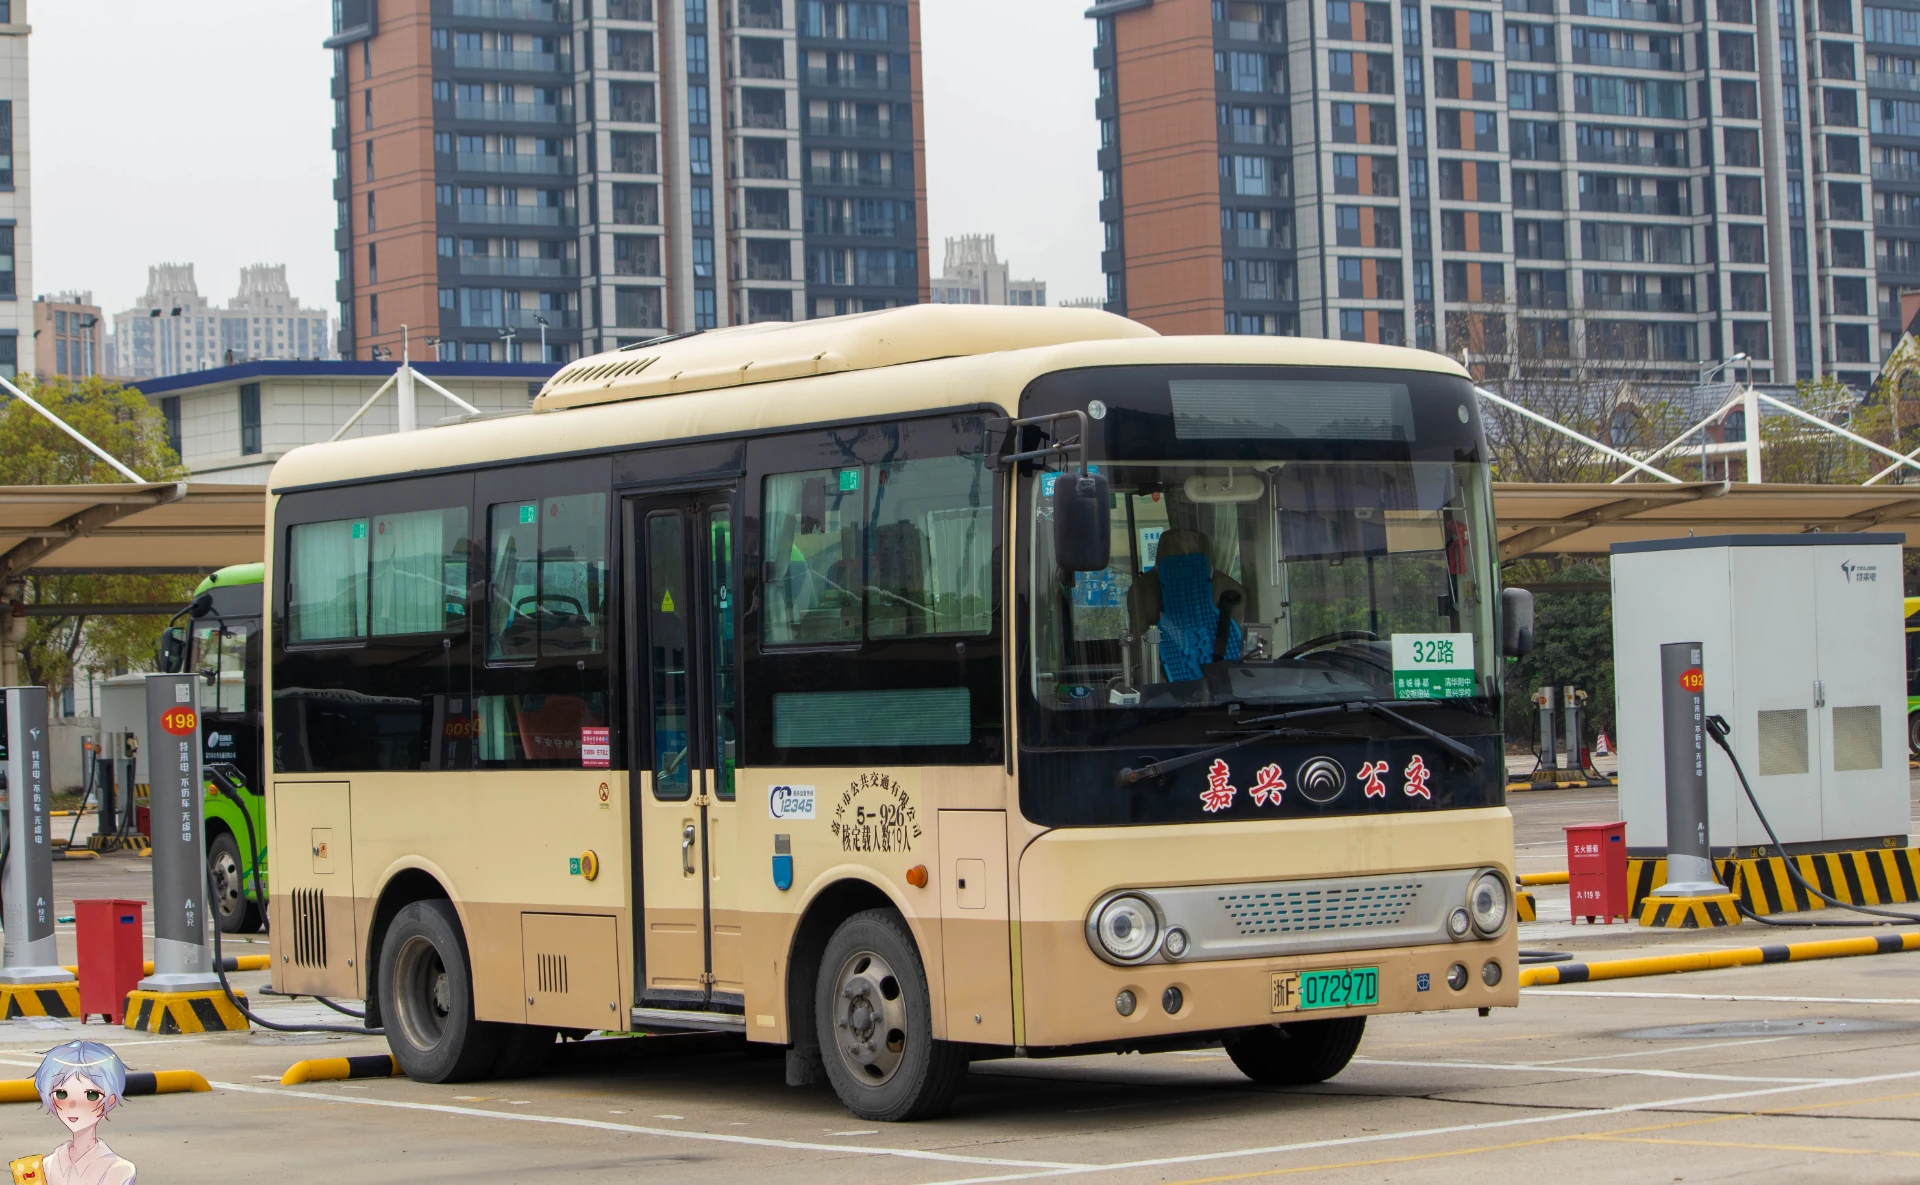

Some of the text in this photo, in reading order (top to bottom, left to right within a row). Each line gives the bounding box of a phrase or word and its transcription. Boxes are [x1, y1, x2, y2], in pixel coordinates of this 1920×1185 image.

[1856, 573, 1877, 582] 特来电
[1413, 640, 1454, 664] 32路
[1444, 677, 1471, 687] 清华附中
[1683, 675, 1703, 687] 192
[1445, 688, 1472, 698] 嘉兴学校
[165, 714, 195, 728] 198
[780, 799, 813, 813] 12345
[842, 824, 911, 853] 核定载人数19人
[1574, 845, 1599, 854] 灭火器箱
[186, 911, 194, 927] 快充
